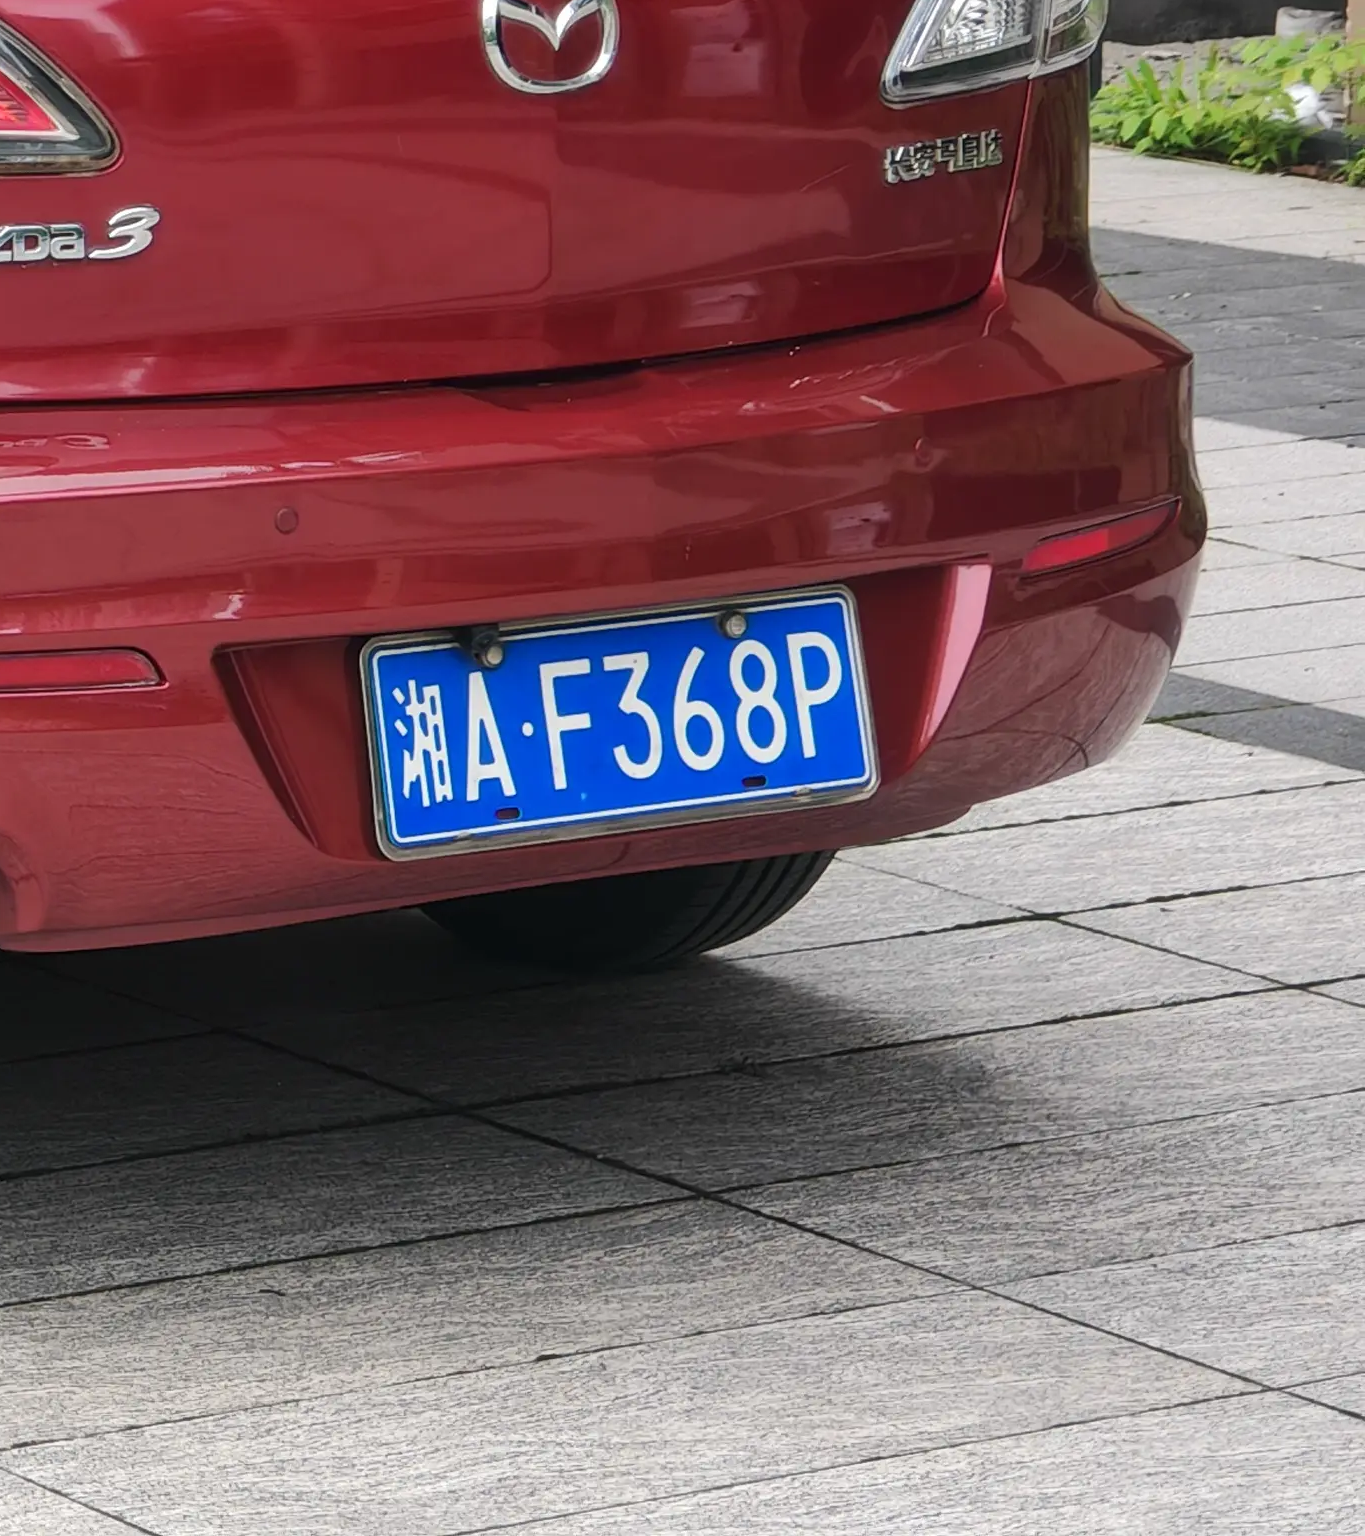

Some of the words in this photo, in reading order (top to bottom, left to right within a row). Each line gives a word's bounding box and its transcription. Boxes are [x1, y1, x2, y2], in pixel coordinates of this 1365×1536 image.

[883, 128, 1005, 184] 长安马自达
[87, 204, 161, 260] 3
